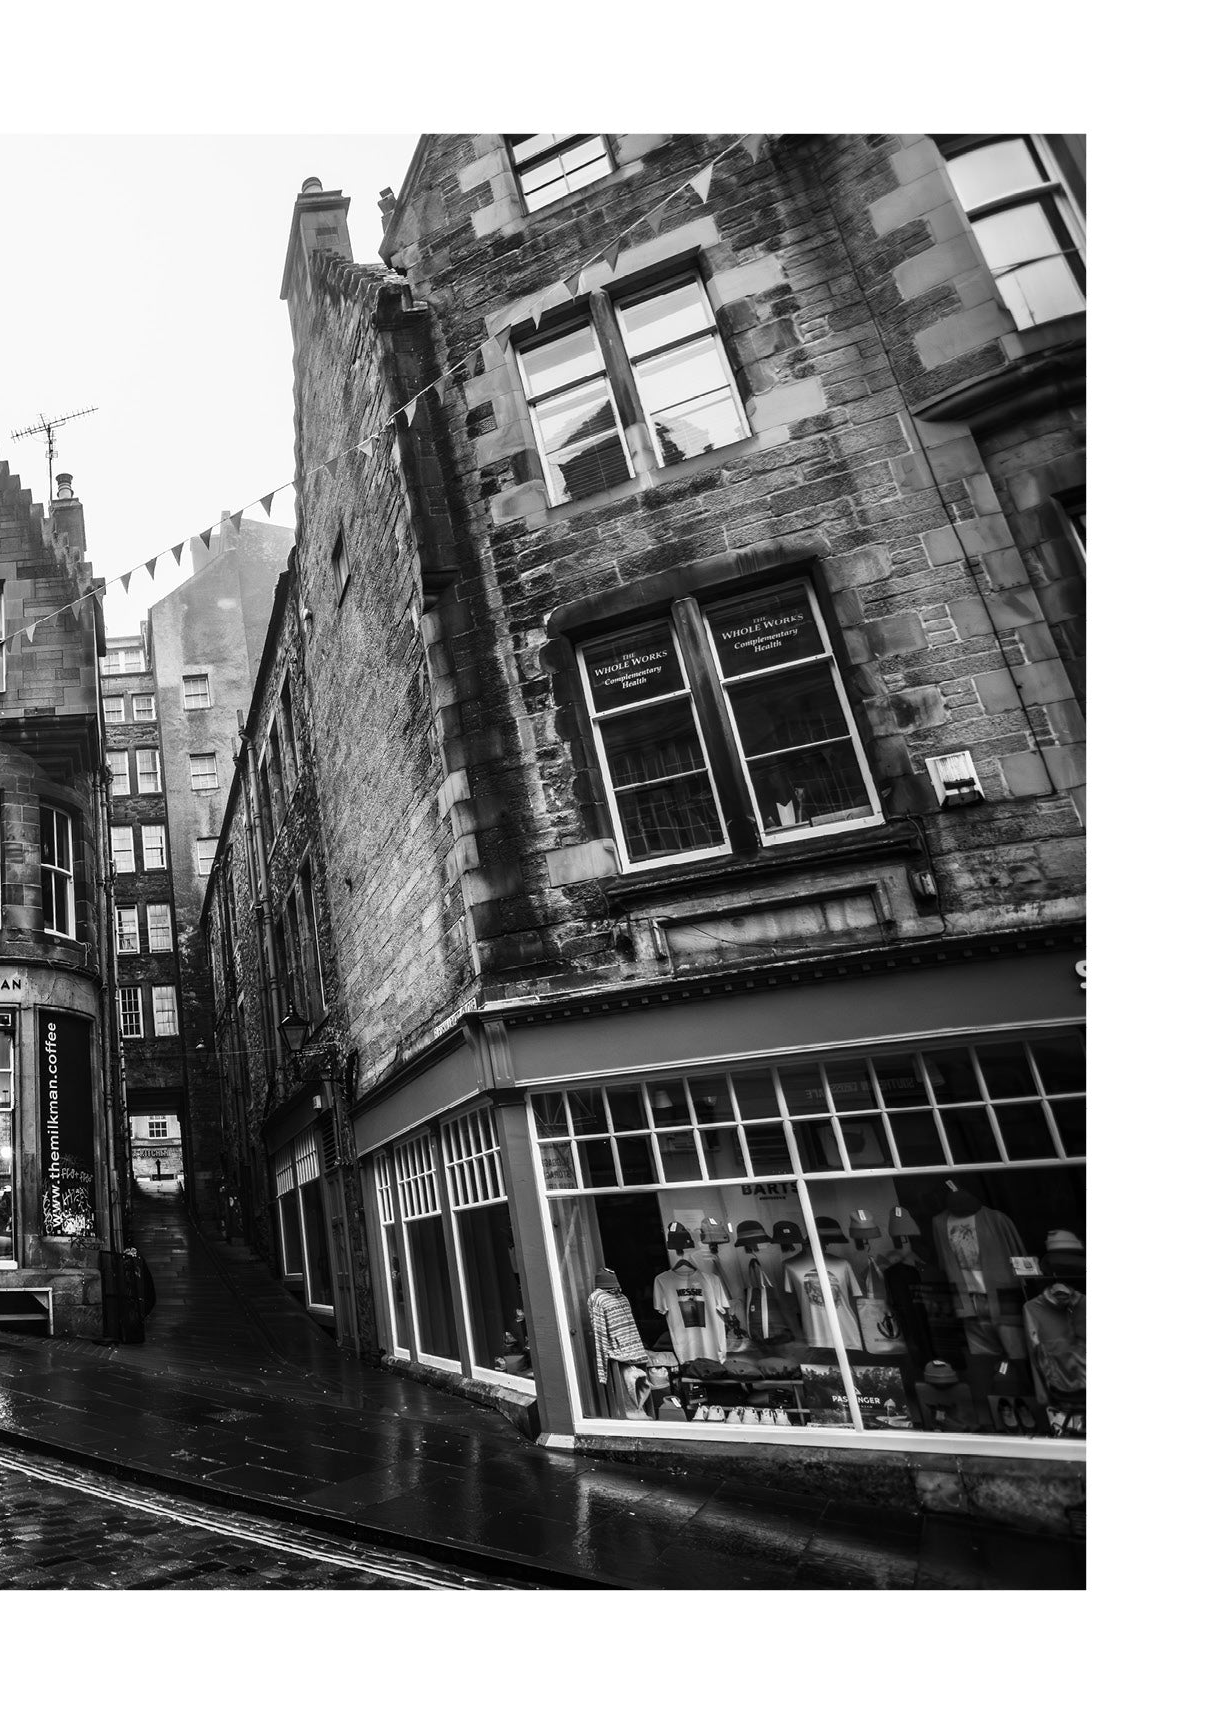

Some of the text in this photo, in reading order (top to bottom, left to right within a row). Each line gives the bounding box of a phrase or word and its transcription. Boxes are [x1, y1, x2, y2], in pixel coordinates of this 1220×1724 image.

[721, 612, 804, 640] WHOLE WORKS
[753, 616, 767, 624] THE
[734, 628, 798, 650] Complementary
[754, 640, 782, 653] Health
[594, 649, 668, 676] WHOLE WORKS
[622, 652, 636, 660] THE
[604, 666, 662, 685] Complementary
[622, 677, 647, 689] Health
[831, 1395, 881, 1405] PASNGER
